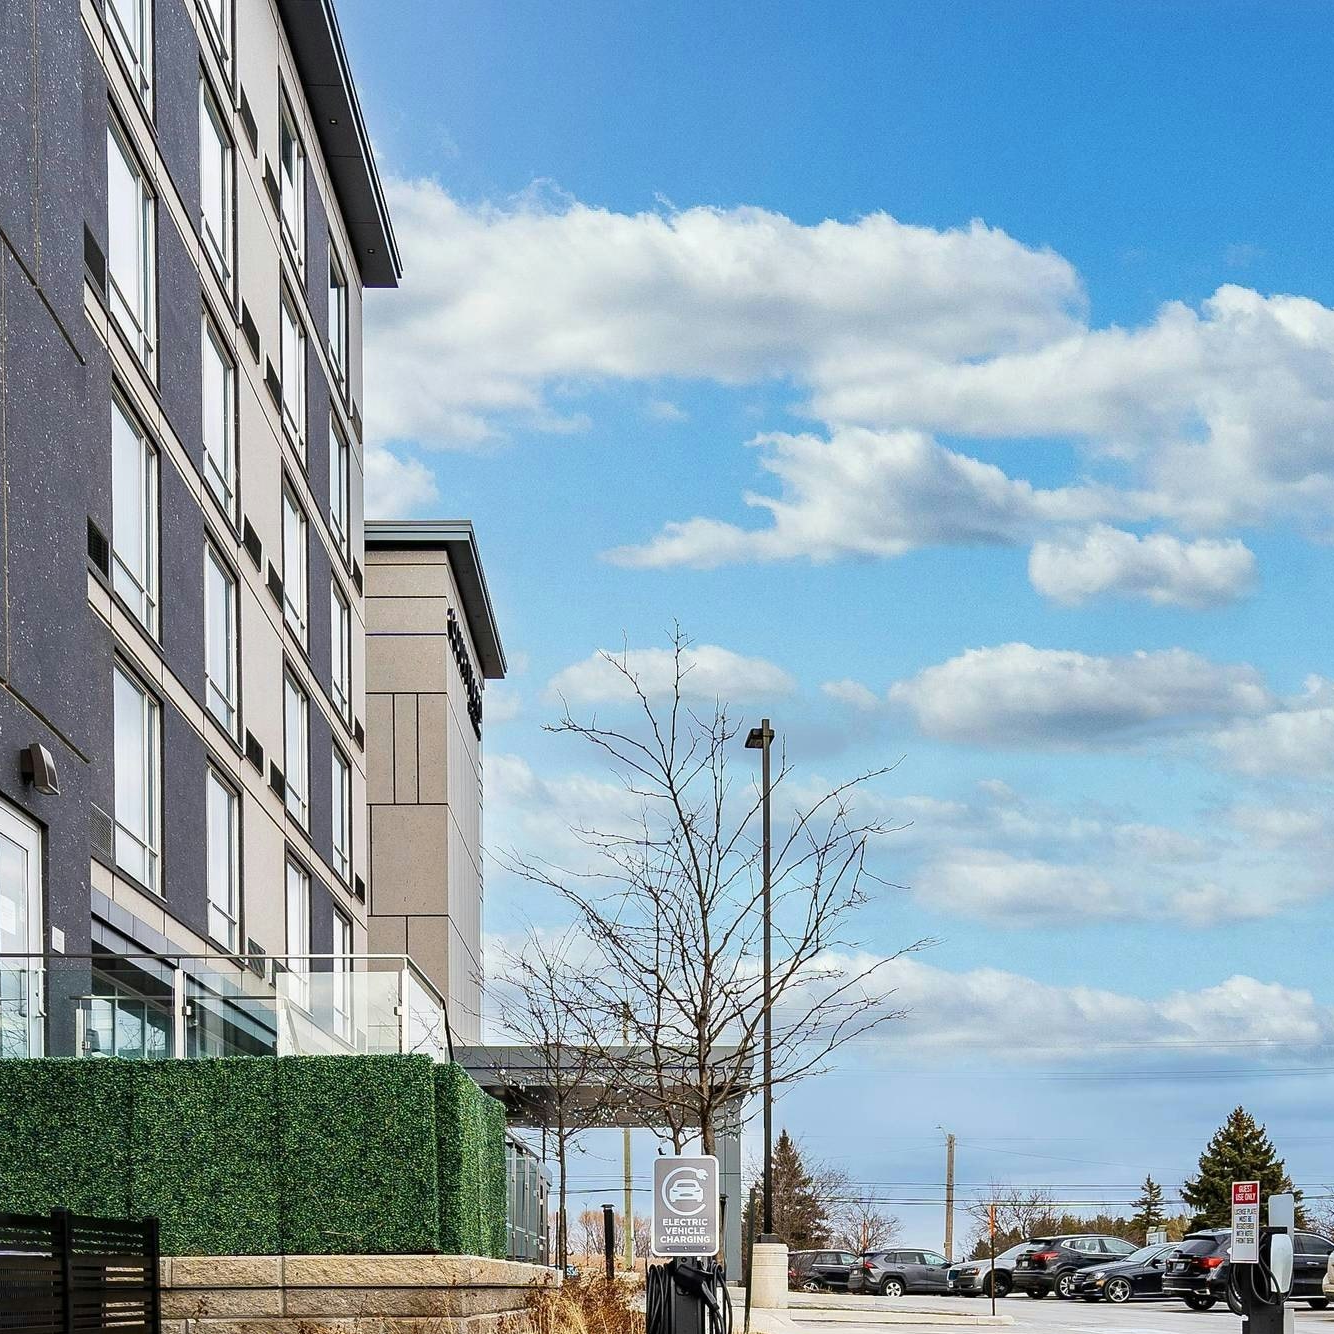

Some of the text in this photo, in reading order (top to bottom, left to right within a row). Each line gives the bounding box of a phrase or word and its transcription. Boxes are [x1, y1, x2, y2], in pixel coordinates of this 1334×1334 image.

[662, 1218, 708, 1226] ELECTRIC
[665, 1227, 706, 1235] VEHICLE
[660, 1235, 711, 1243] CHARGING
